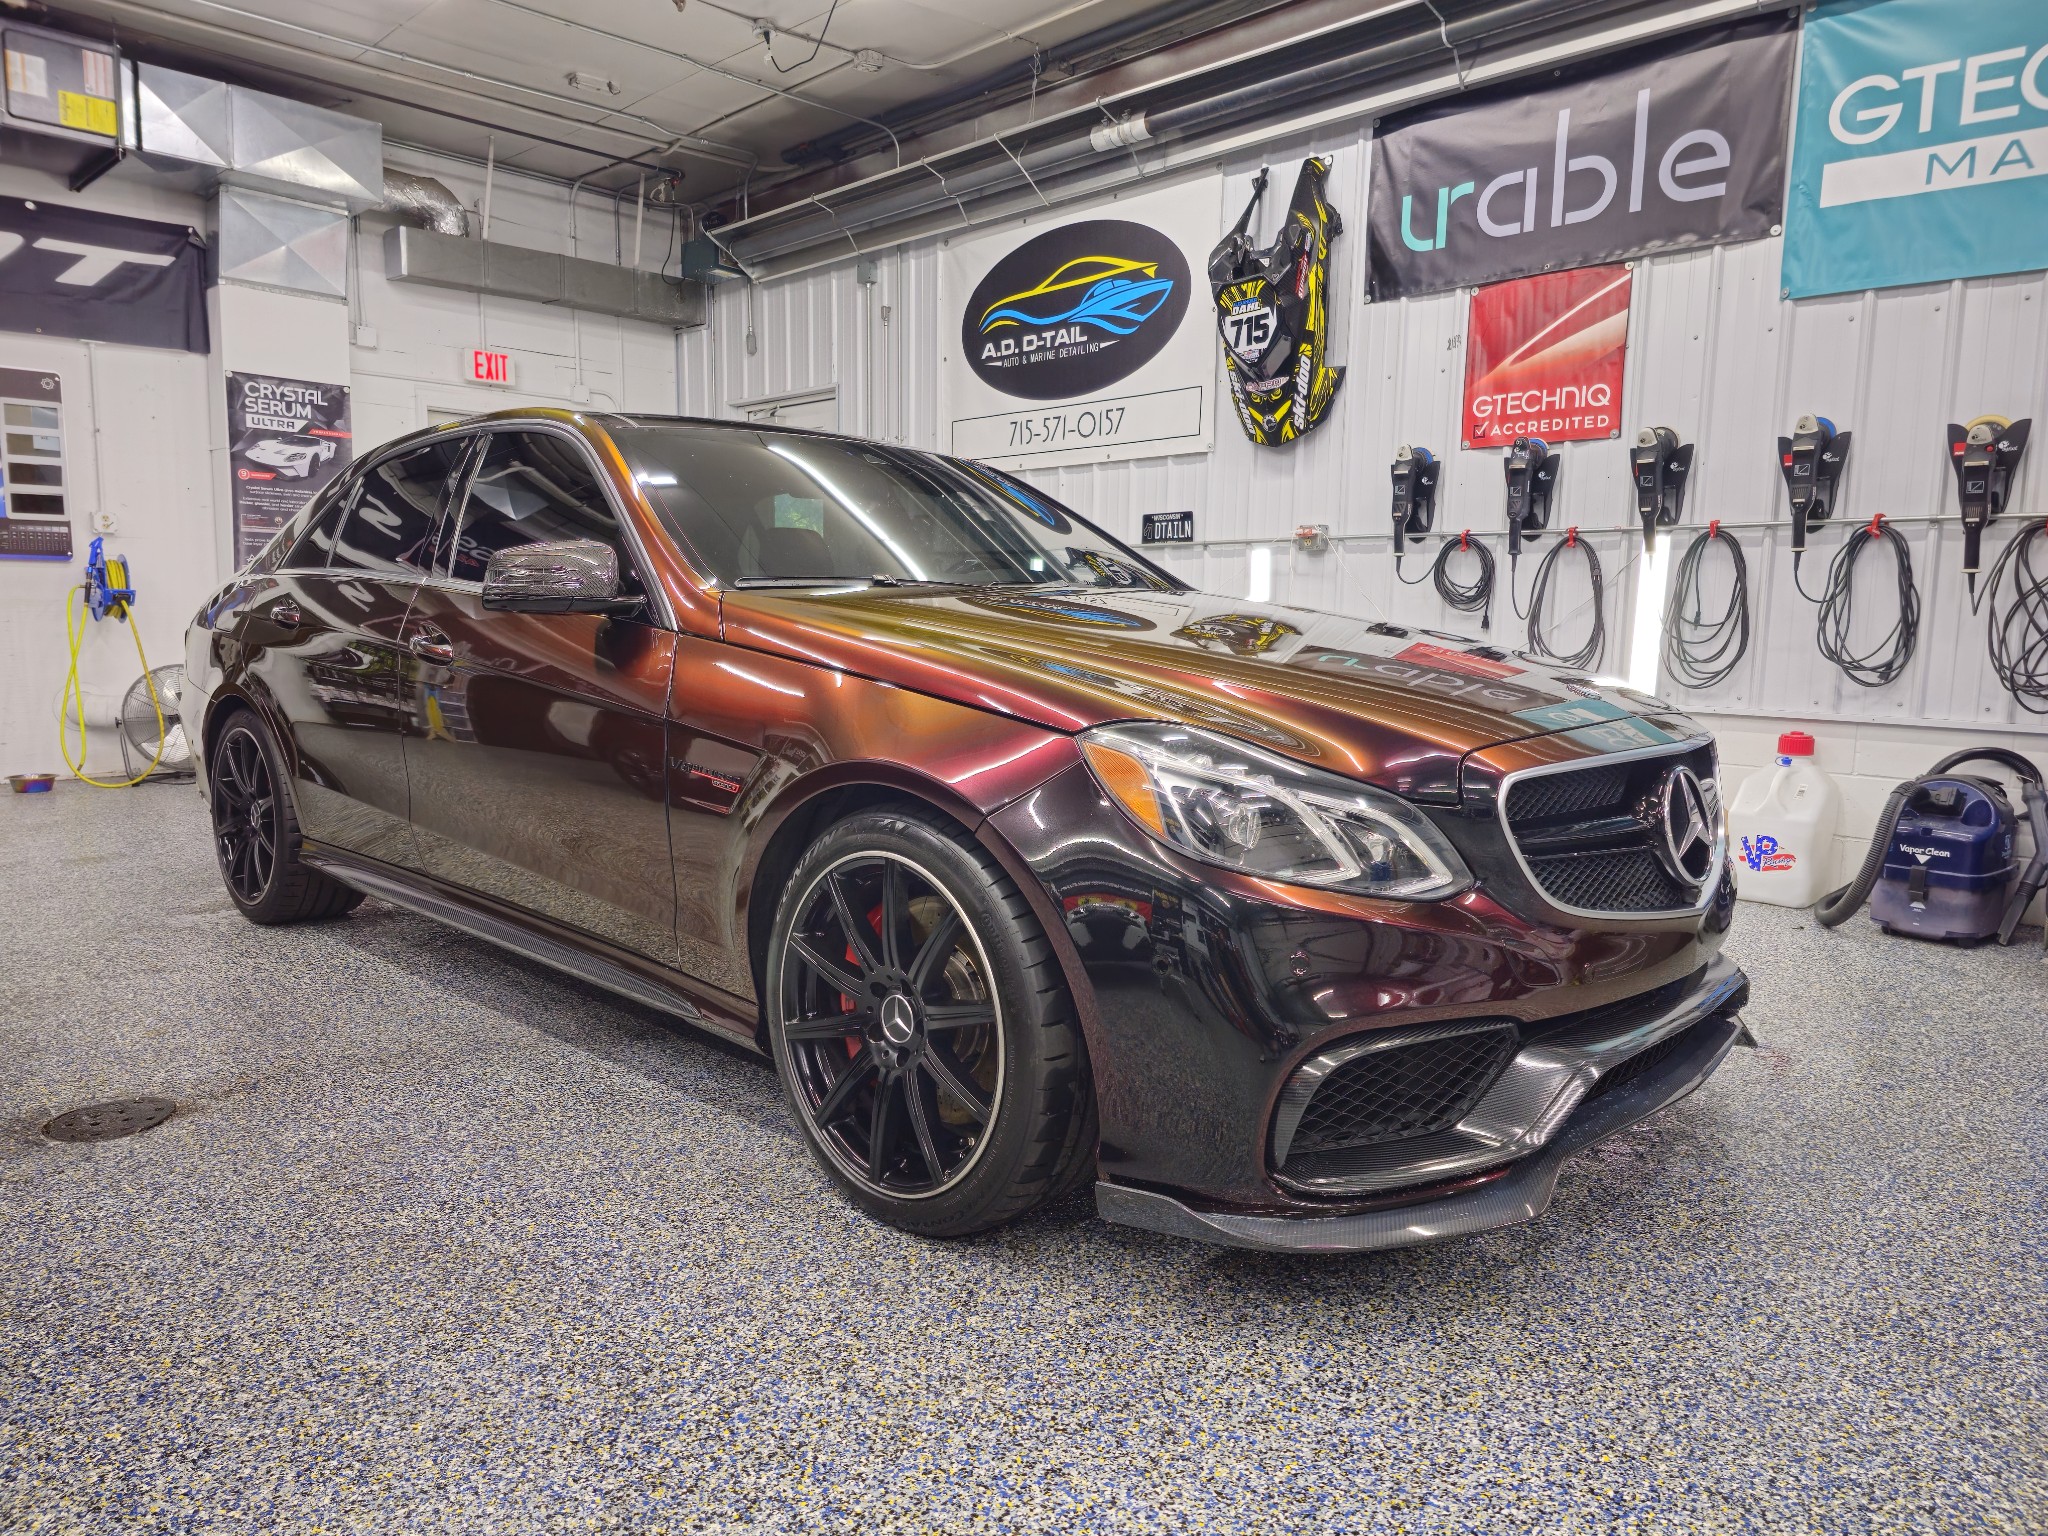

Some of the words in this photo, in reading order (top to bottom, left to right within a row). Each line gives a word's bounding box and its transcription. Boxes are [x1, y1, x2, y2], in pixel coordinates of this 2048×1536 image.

[1401, 88, 1731, 252] urable
[1232, 302, 1260, 316] DAHL
[981, 338, 1019, 360] A.D.
[1022, 326, 1088, 352] D-TAIL
[1230, 312, 1270, 350] 715
[474, 350, 508, 382] EXIT
[1003, 356, 1019, 368] AUTO
[1022, 355, 1027, 365] &
[1030, 350, 1056, 363] MARINE
[1059, 342, 1099, 358] DETAILING
[244, 381, 328, 406] CRYSTAL
[1472, 383, 1611, 418] GTECHNIQ
[244, 398, 311, 419] SERUM
[251, 416, 295, 429] ULTRA
[1009, 407, 1125, 446] 715-571-0157
[1490, 415, 1609, 436] ACCREDITED
[1154, 521, 1191, 539] DTAILN
[1740, 834, 1779, 872] VP
[1900, 843, 1924, 855] Vapor
[1925, 847, 1950, 857] Clean
